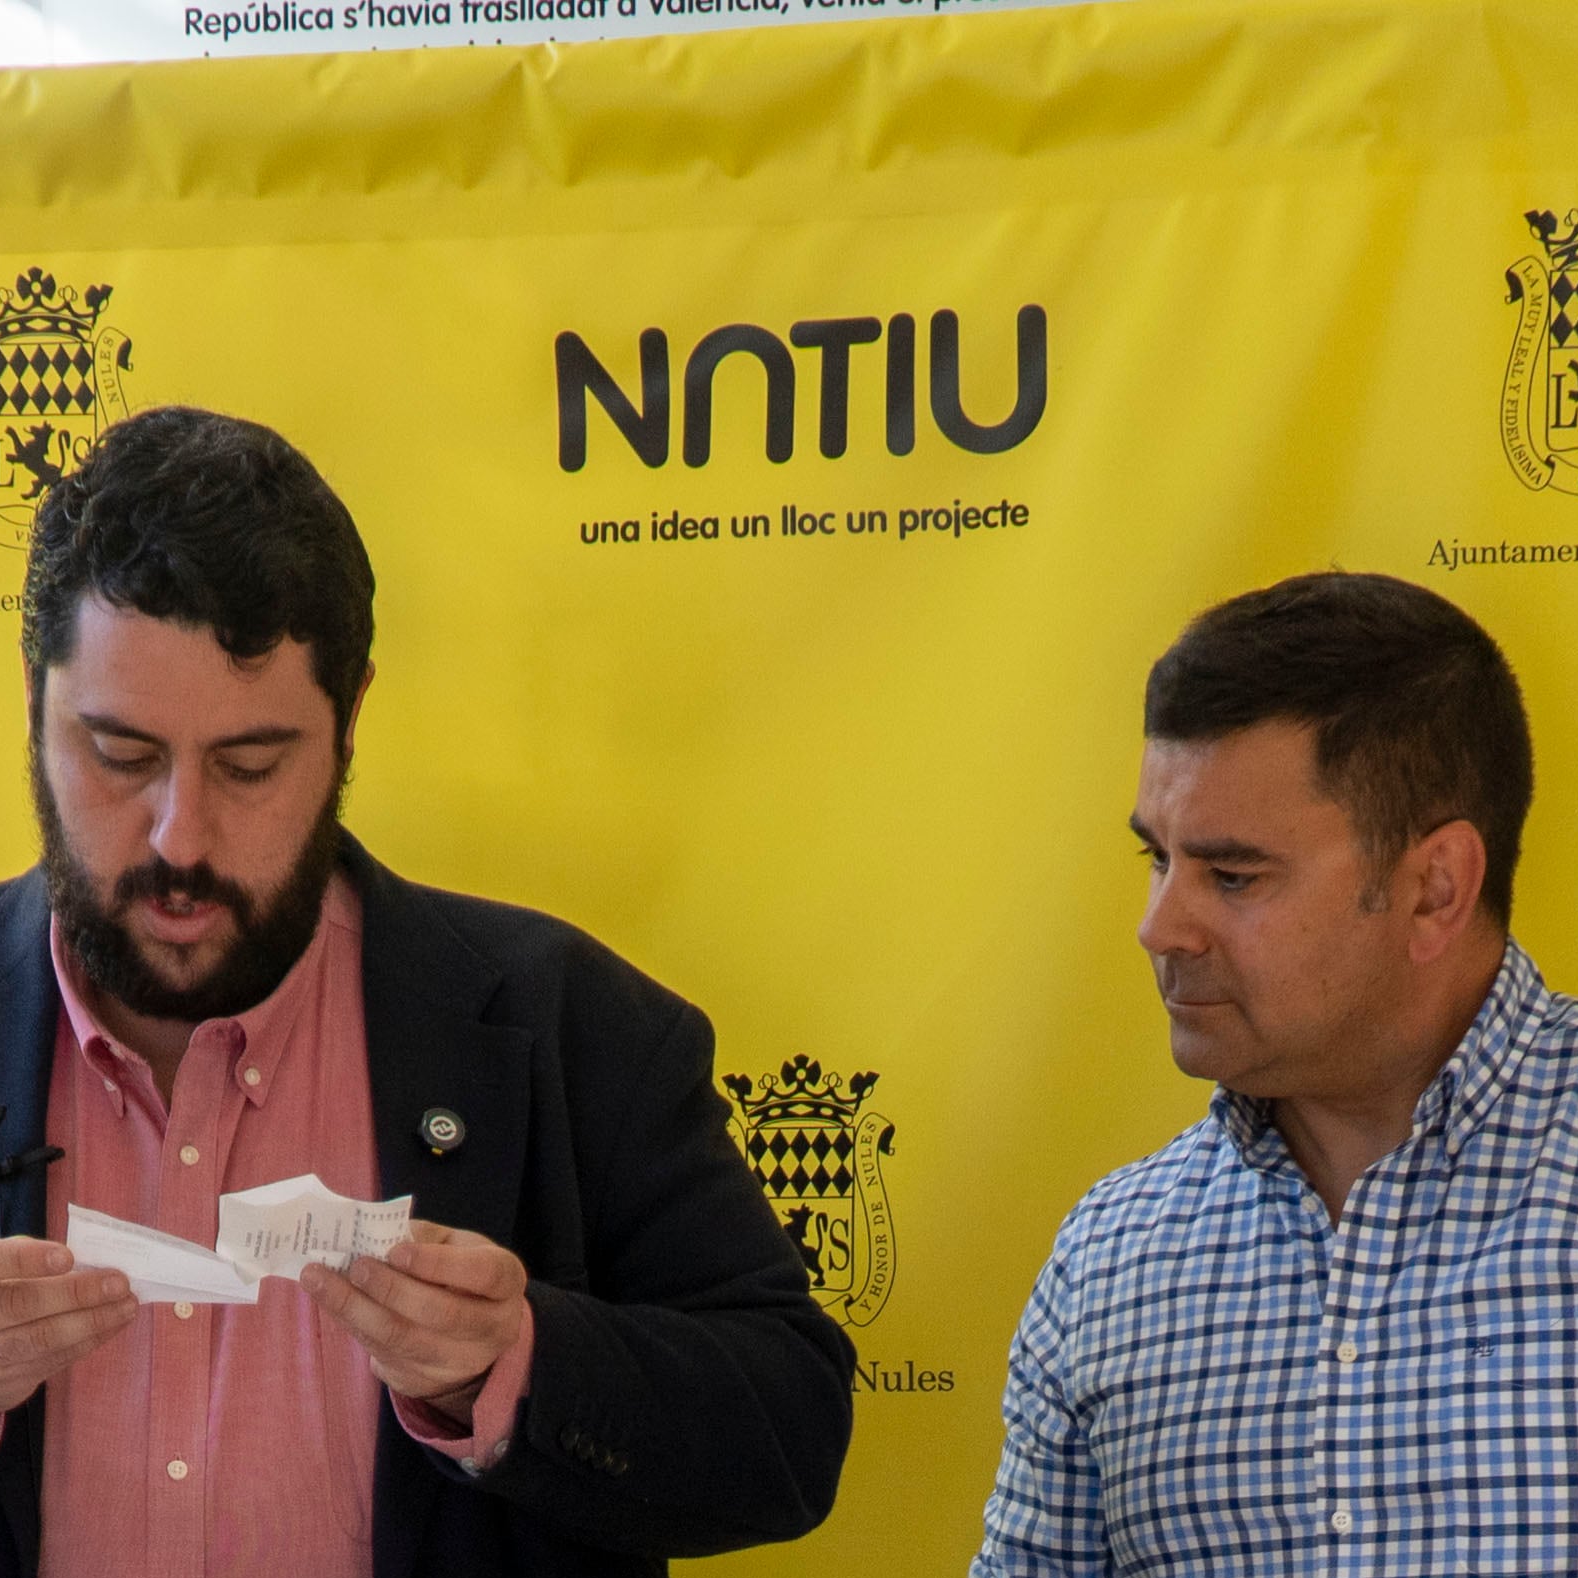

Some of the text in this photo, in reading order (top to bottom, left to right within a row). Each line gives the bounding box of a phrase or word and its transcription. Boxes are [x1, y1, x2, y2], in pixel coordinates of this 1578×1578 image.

[184, 3, 334, 41] República
[461, 0, 607, 23] traslladat
[1522, 265, 1538, 289] LA
[1526, 291, 1544, 334] MUY
[100, 337, 120, 405] NULES
[1513, 337, 1532, 375] LEAL
[1551, 374, 1578, 429] L
[580, 500, 1030, 544] una idea un lloc un projecte
[861, 1121, 879, 1187] NULES
[873, 1201, 884, 1225] DE
[872, 1234, 888, 1298] HONOR
[852, 1360, 955, 1393] Nules
